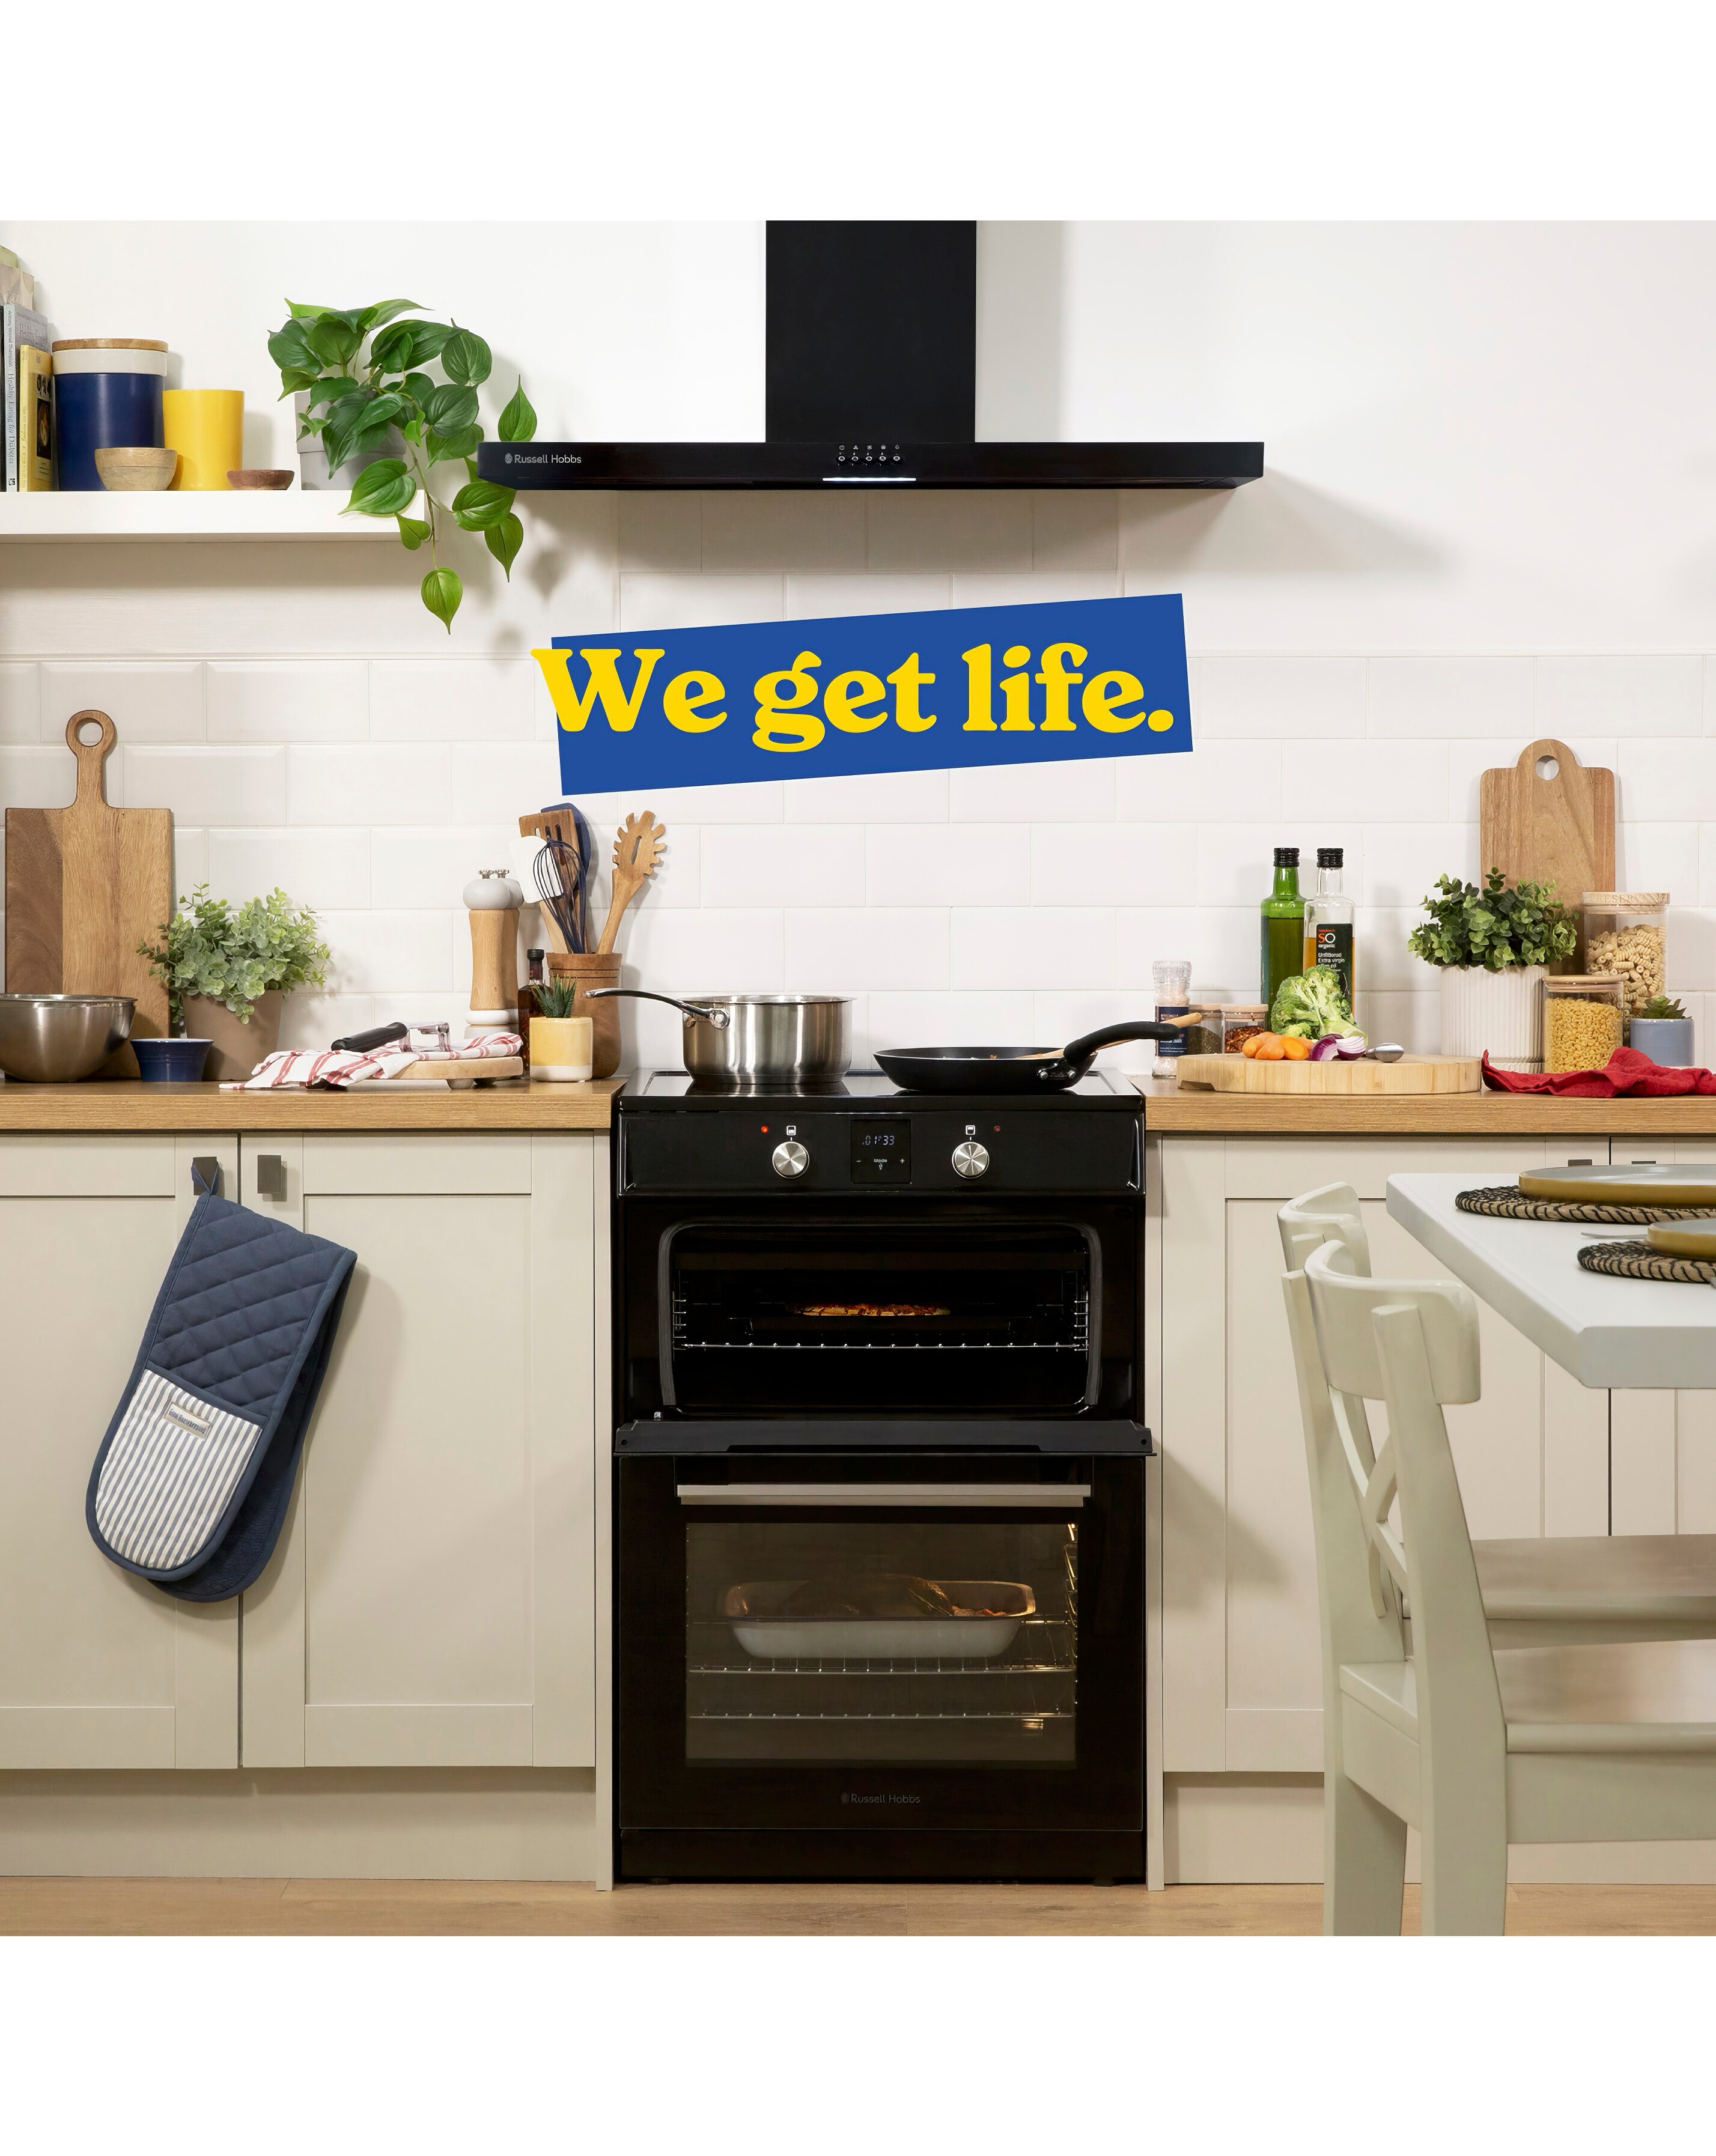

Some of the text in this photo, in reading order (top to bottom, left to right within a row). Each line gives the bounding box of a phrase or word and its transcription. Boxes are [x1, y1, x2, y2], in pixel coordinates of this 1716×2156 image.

[514, 454, 582, 463] Russell Hobbs
[1318, 933, 1336, 943] SO
[851, 1793, 920, 1803] Russell Hobbs
